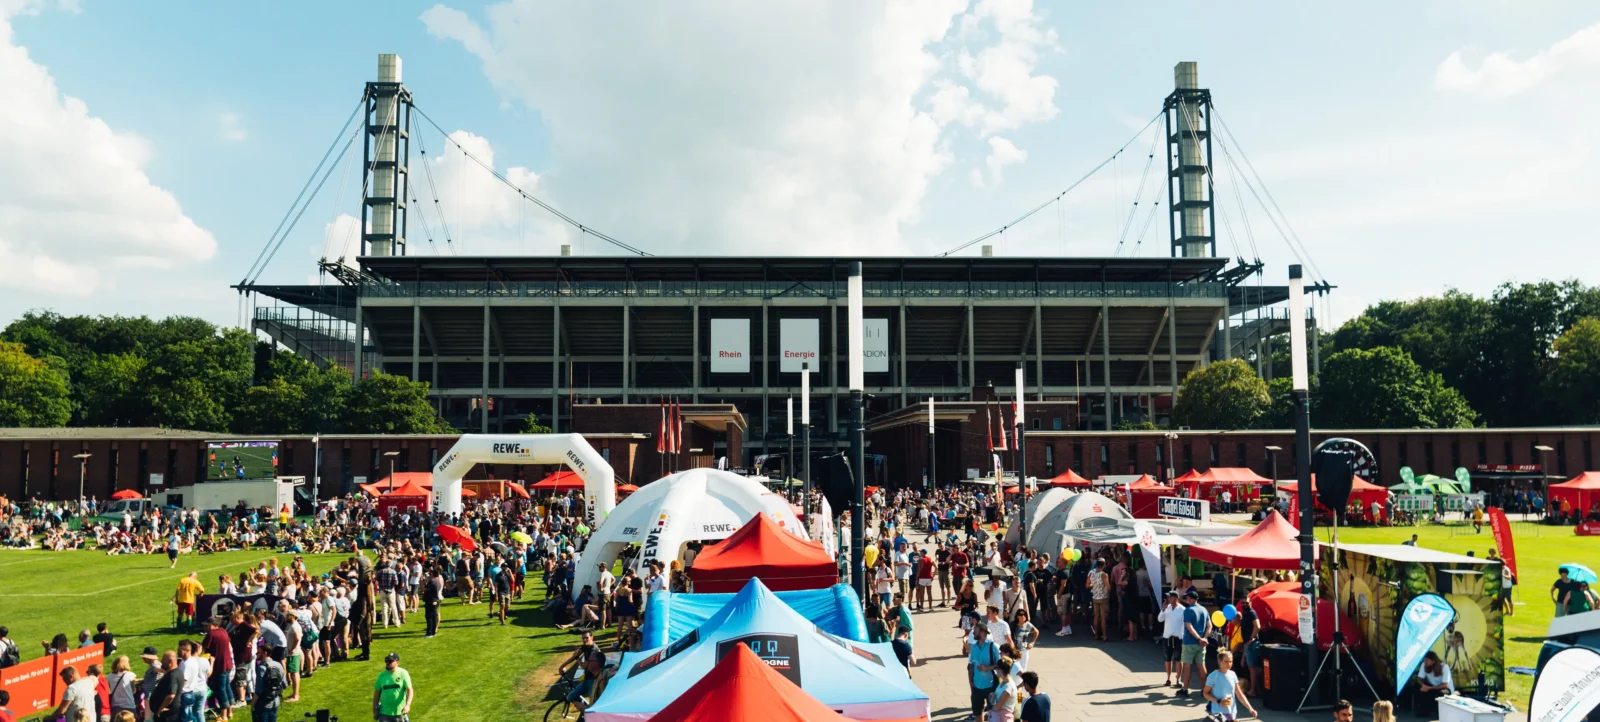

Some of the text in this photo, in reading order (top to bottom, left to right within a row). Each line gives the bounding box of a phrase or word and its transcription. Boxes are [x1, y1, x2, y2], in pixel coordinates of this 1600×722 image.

[719, 350, 742, 358] Rhein
[784, 350, 815, 359] Energie
[863, 350, 887, 358] ADION
[493, 443, 520, 454] REWE
[438, 454, 455, 472] REWE
[566, 450, 585, 470] REWE
[703, 524, 731, 532] REWE
[642, 528, 662, 568] REWE
